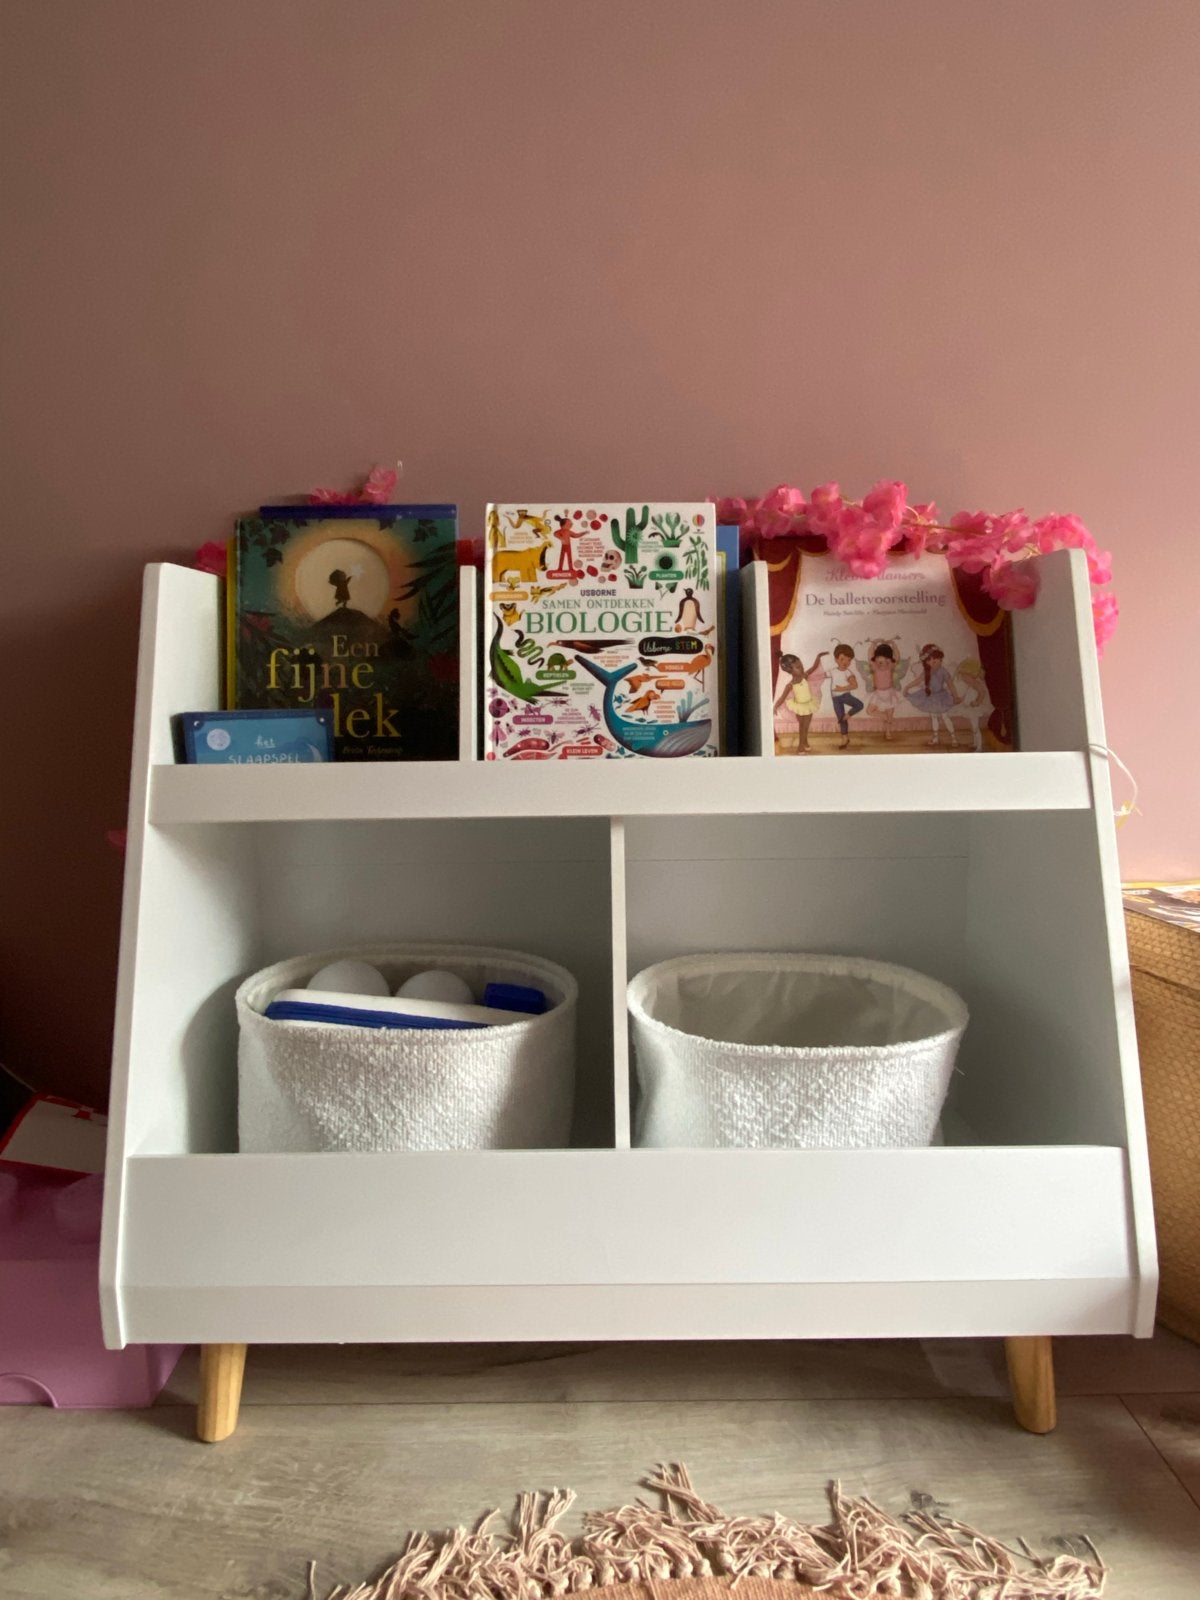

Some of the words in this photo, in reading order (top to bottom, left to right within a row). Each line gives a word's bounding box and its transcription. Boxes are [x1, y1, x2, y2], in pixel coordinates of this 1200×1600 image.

[580, 589, 617, 597] USBORNE
[805, 593, 825, 606] De
[829, 591, 947, 607] balletvoorstelling
[542, 599, 581, 609] SAMEN
[587, 598, 655, 609] ONTDEKKEN
[525, 611, 673, 634] BIOLOGIE
[331, 634, 379, 658] Een
[675, 640, 698, 650] STEM
[266, 647, 374, 703] fijne
[330, 693, 402, 738] lek
[255, 734, 276, 748] het
[228, 753, 302, 764] SLAAPSPEL
